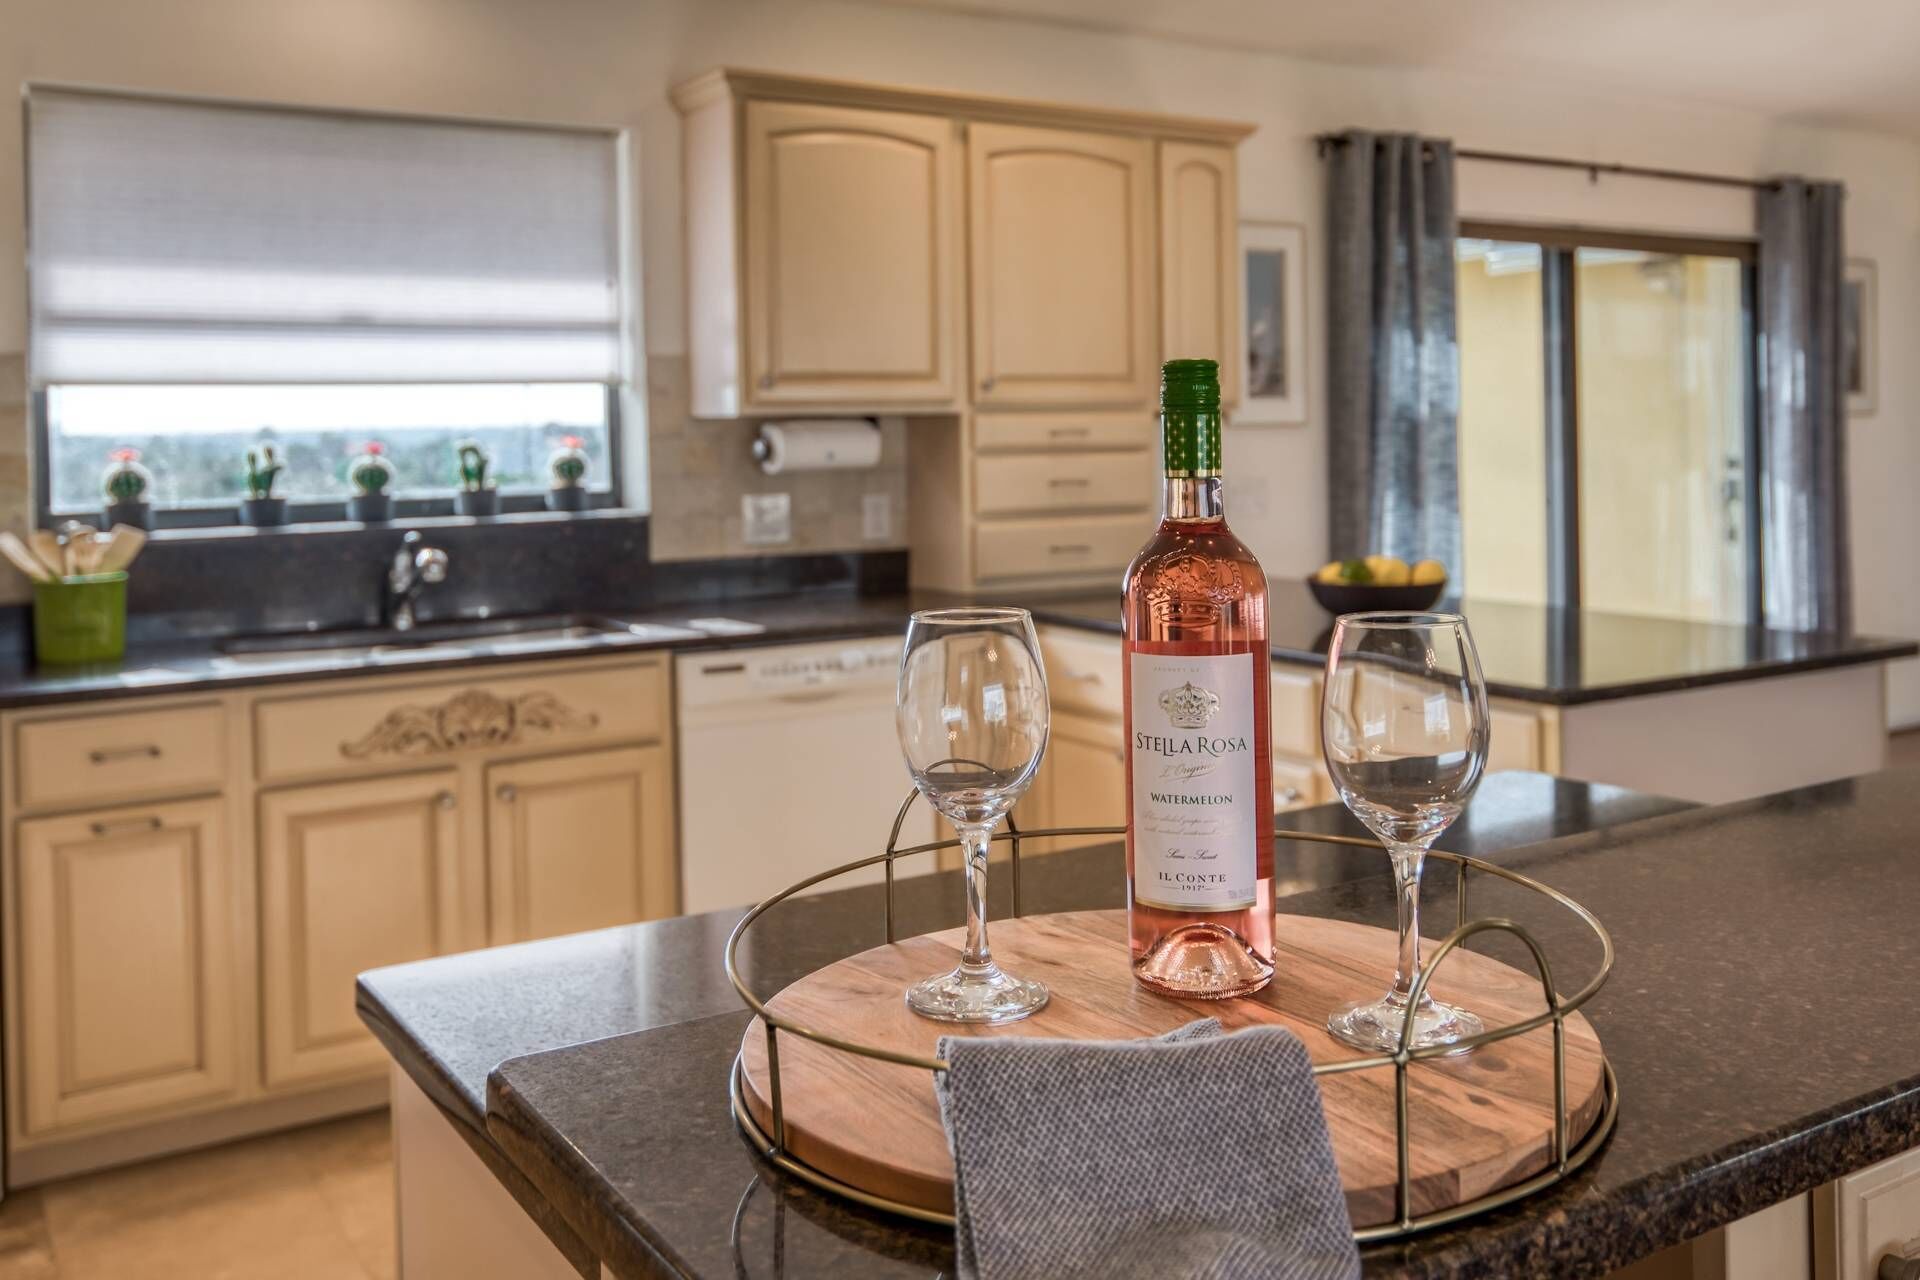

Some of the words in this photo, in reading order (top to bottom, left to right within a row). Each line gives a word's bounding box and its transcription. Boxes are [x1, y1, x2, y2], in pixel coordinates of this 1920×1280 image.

[1136, 732, 1192, 757] STELLA
[1198, 736, 1247, 757] ROSA
[1151, 792, 1233, 805] WATERMELON
[1159, 871, 1172, 882] IL
[1176, 872, 1227, 884] CONTE
